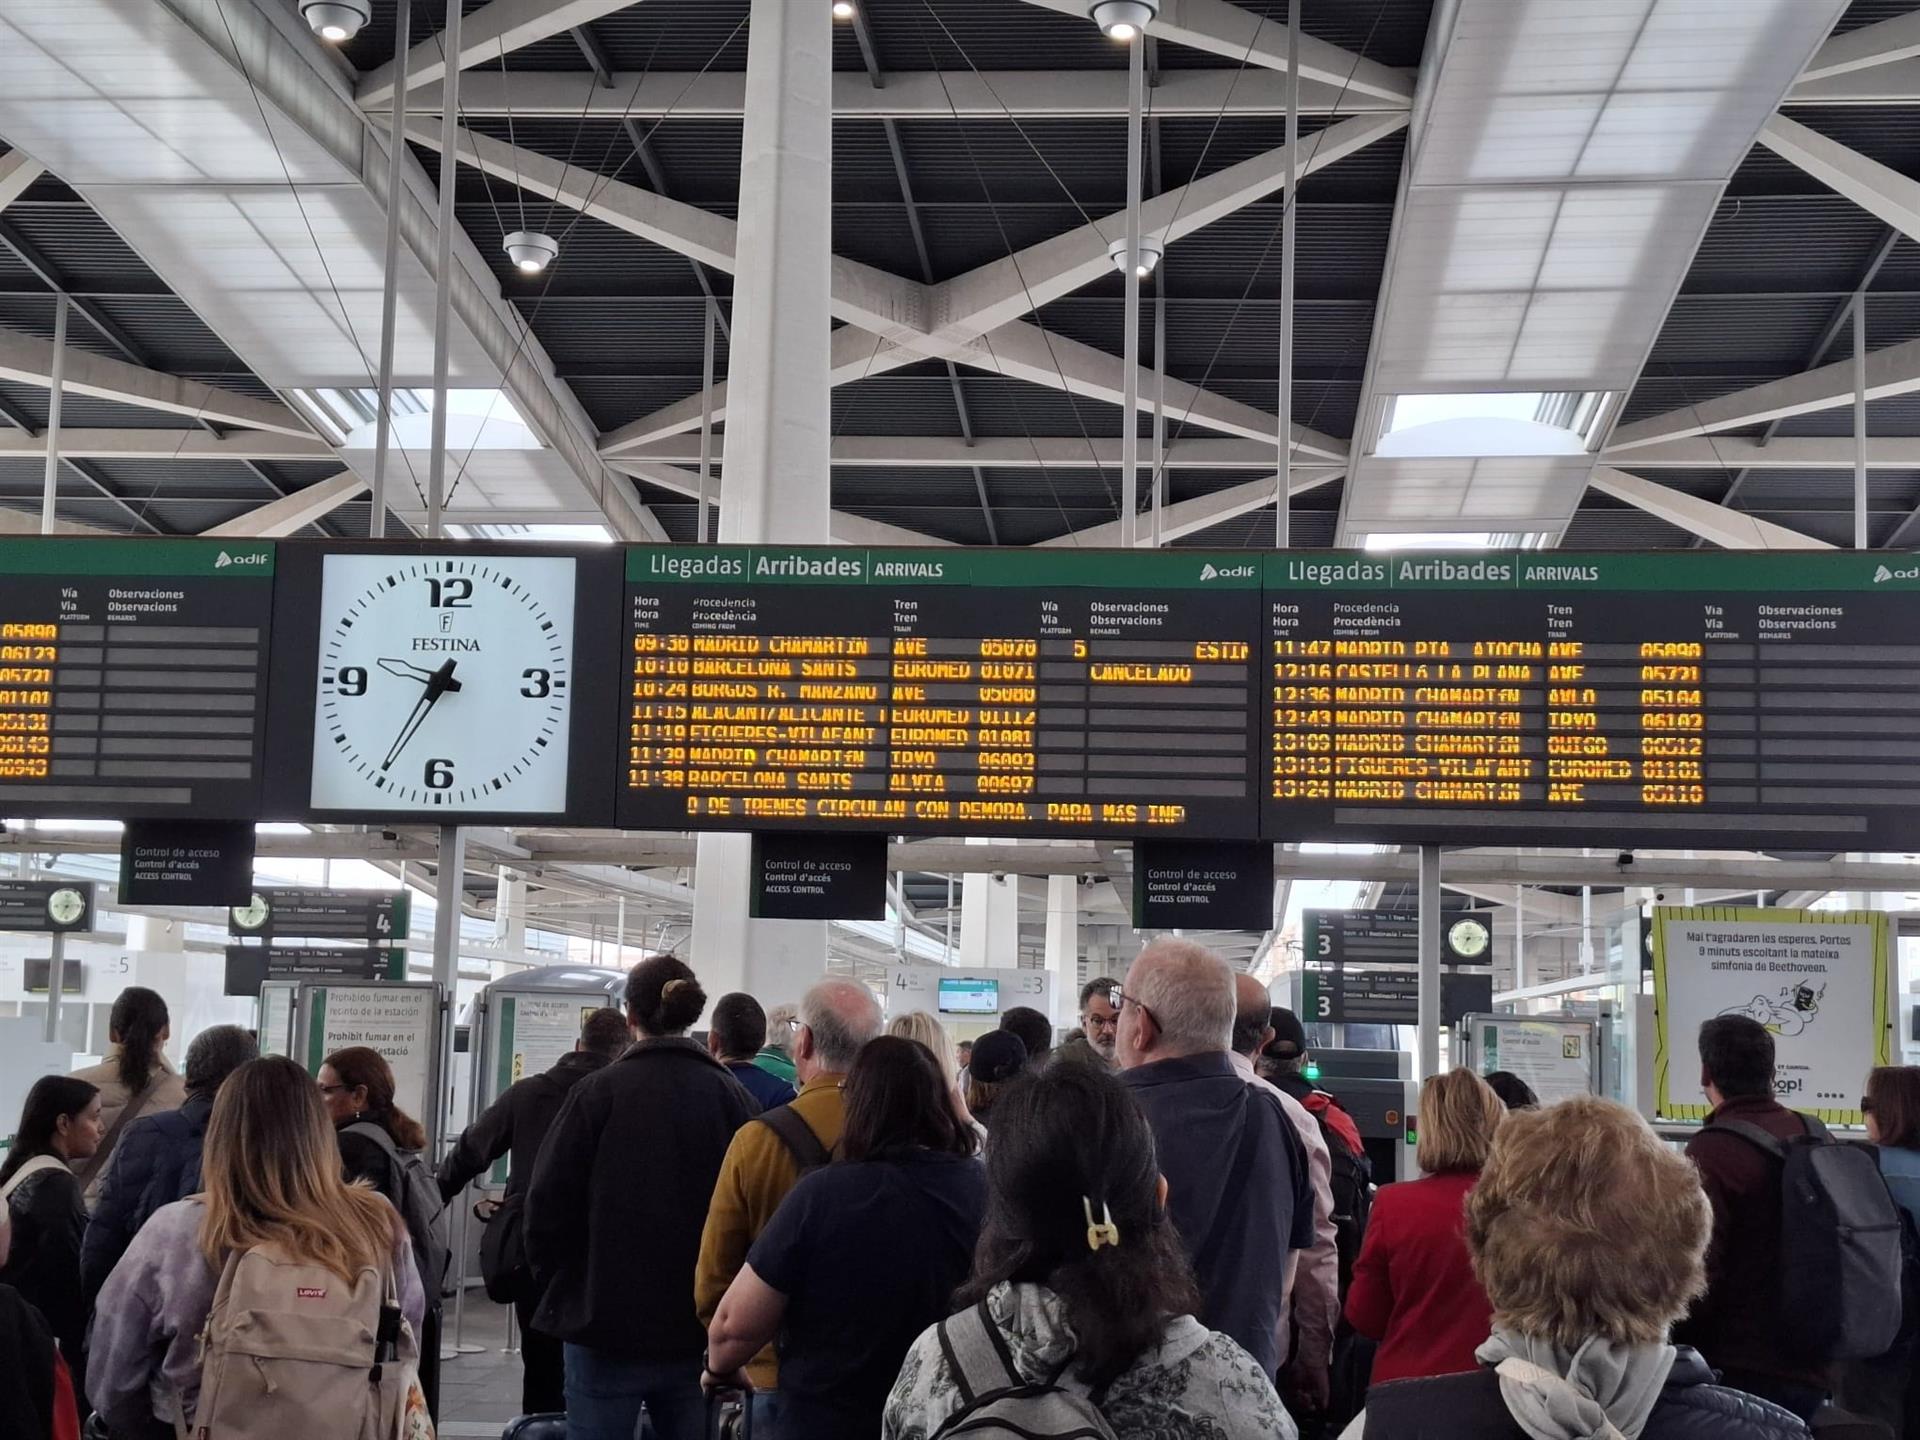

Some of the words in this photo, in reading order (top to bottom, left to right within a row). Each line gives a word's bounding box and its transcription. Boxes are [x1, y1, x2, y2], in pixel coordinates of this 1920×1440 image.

[233, 554, 268, 565] adif
[651, 554, 742, 578] Llegadas
[756, 556, 861, 576] Arribades
[875, 563, 943, 577] ARRIVALS
[1220, 566, 1254, 578] adif
[1289, 561, 1384, 584] Llegadas
[1400, 561, 1510, 580] Arribades
[1525, 566, 1598, 580] ARRIVALS
[62, 588, 78, 598] Vía
[109, 589, 184, 600] Observaciones
[424, 578, 473, 608] 12
[634, 596, 659, 606] Hora
[694, 598, 756, 609] Procedencia
[894, 600, 918, 610] Tren
[61, 602, 77, 612] Via
[108, 602, 177, 612] Observacions
[1042, 602, 1058, 612] Vía
[1090, 602, 1168, 613] Observaciones
[1273, 603, 1298, 613] Hora
[1334, 603, 1400, 613] Procedencia
[1548, 605, 1572, 615] Tren
[1758, 606, 1843, 615] Observaciones
[634, 609, 659, 620] Hora
[693, 611, 756, 622] Procedència
[894, 613, 917, 622] Tren
[1041, 614, 1058, 625] Via
[442, 616, 450, 630] F
[1090, 615, 1162, 626] Observacions
[1273, 617, 1298, 626] Hora
[1334, 616, 1400, 626] Procedència
[1548, 618, 1572, 628] Tren
[1705, 619, 1723, 629] Via
[1758, 619, 1836, 629] Observacions
[412, 638, 480, 651] FESTINA
[894, 638, 927, 654] AVE
[1075, 640, 1085, 656] 5
[1275, 641, 1330, 654] 11:47
[694, 659, 791, 675] BARCELONA
[802, 660, 856, 676] SANTS
[1091, 664, 1191, 681] CANCELADO
[1275, 664, 1331, 677] 12:16
[338, 666, 368, 696] 9
[520, 668, 550, 698] 3
[1336, 688, 1405, 703] MADRID
[1336, 711, 1405, 727] MADRID
[1336, 734, 1404, 751] MADRID
[424, 759, 454, 788] 6
[1549, 760, 1632, 777] EUROMED
[1335, 781, 1404, 798] MADRID
[743, 798, 807, 815] TRENES
[817, 800, 905, 817] CIRCULAN
[916, 801, 949, 818] CON
[1048, 804, 1092, 821] PARA
[136, 847, 169, 857] Control
[172, 848, 186, 858] de
[188, 850, 220, 858] acceso
[135, 860, 166, 869] Control
[765, 860, 800, 870] Control
[803, 860, 816, 870] de
[819, 862, 851, 870] acceso
[135, 872, 159, 880] ACCESS
[161, 873, 192, 881] CONTROL
[765, 872, 796, 881] Control
[1148, 869, 1183, 879] Control
[1188, 869, 1200, 879] de
[1203, 871, 1236, 880] acceso
[793, 886, 824, 894] CONTROL
[1148, 882, 1180, 891] Control
[376, 914, 390, 933] 4
[1318, 935, 1331, 954] 3
[120, 957, 128, 974] 5
[896, 974, 907, 990] 4
[1034, 977, 1043, 993] 3
[373, 994, 397, 1002] fumar
[361, 1007, 372, 1016] de
[1318, 996, 1330, 1016] 3
[328, 1032, 362, 1040] Prohibit
[365, 1032, 390, 1041] fumar
[407, 1033, 415, 1041] el
